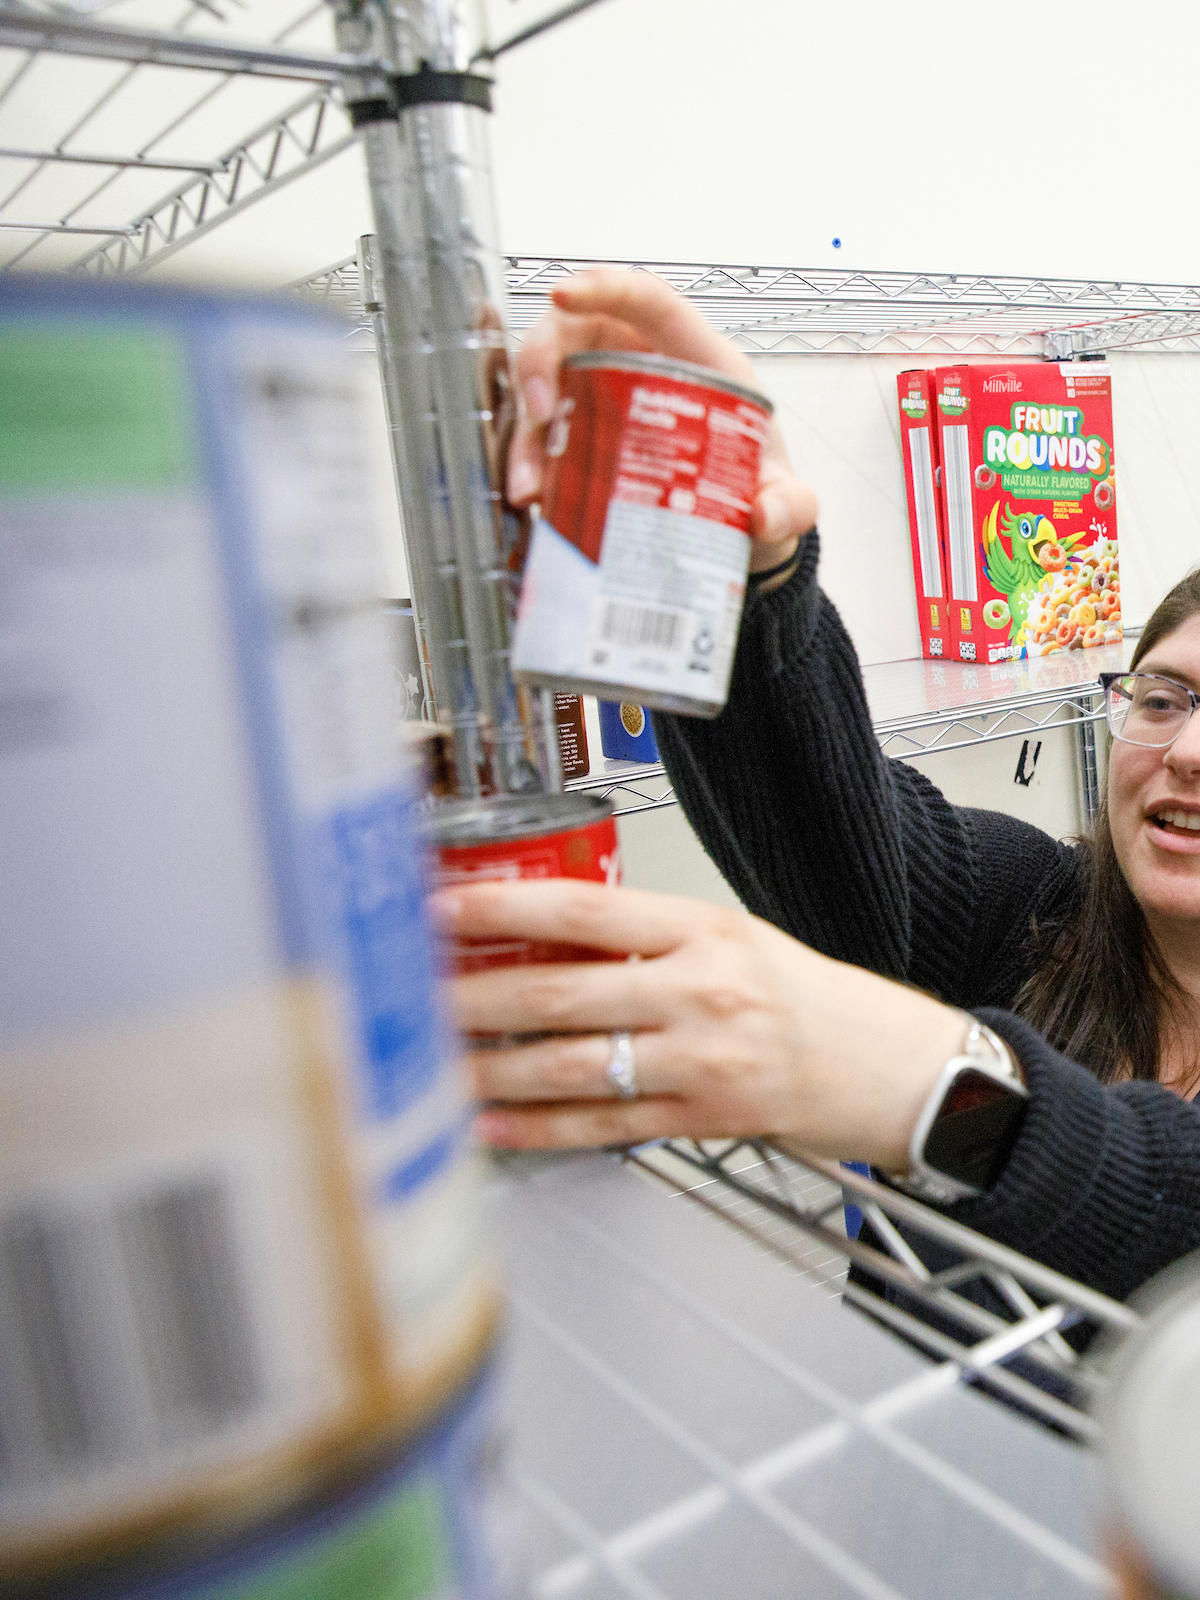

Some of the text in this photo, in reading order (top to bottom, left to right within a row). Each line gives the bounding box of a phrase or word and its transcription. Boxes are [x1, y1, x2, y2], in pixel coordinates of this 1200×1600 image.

[983, 379, 1022, 393] Millville
[1014, 406, 1079, 435] FRUIT
[986, 430, 1107, 475] ROUNDS
[1003, 474, 1090, 490] NATURALLY FLAVORED
